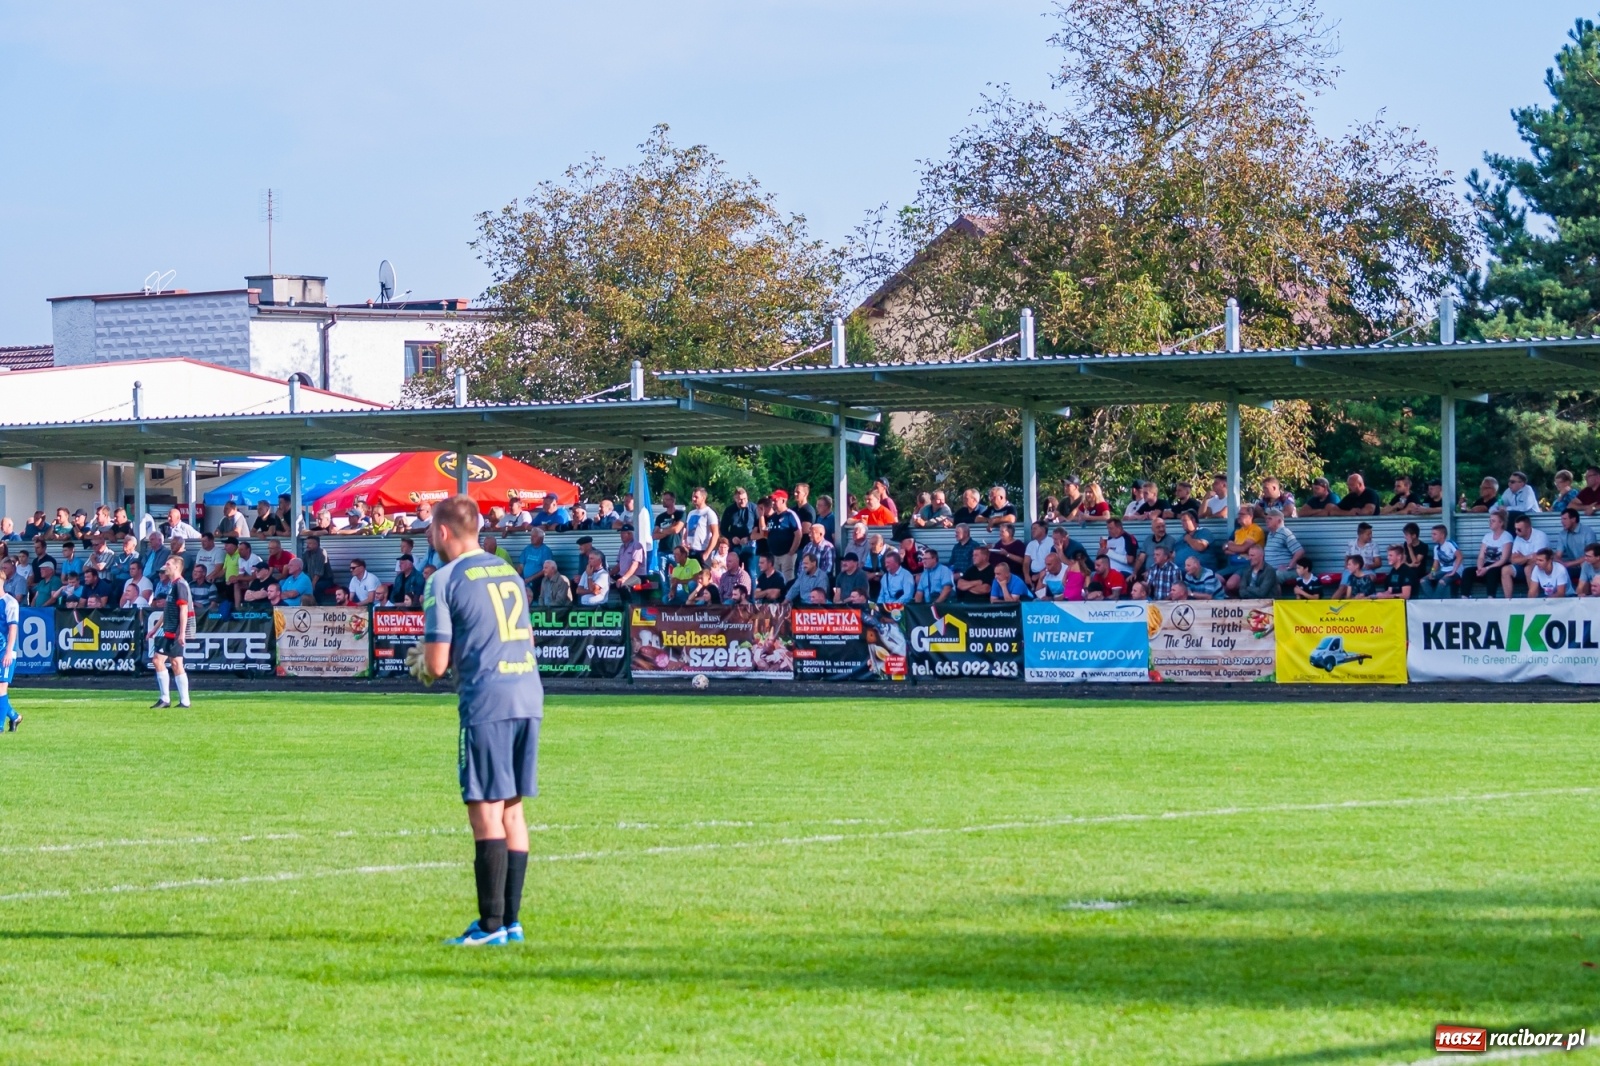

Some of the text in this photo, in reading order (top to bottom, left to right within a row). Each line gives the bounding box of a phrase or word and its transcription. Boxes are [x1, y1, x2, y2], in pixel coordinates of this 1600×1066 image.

[323, 612, 346, 622] Kebab
[487, 581, 530, 642] 12
[662, 612, 694, 622] Producent
[1211, 607, 1243, 618] Kebab
[377, 614, 424, 626] KREWETK
[530, 612, 563, 627] ALL
[795, 612, 858, 625] KREWETKA
[1027, 614, 1060, 624] SZYBKI
[323, 624, 346, 637] Frytki
[969, 628, 1017, 638] BUDUJEMY
[1211, 621, 1242, 634] Frytki
[1294, 626, 1384, 634] POMOC DROGOWA 24h
[1422, 614, 1599, 652] KERAKOLL
[101, 630, 134, 638] BUDUJEMY
[662, 631, 727, 646] kiełbasa
[1032, 632, 1094, 642] INTERNET
[101, 643, 111, 651] OD
[112, 643, 117, 651] A
[131, 643, 135, 651] Z
[323, 638, 342, 649] Lody
[970, 643, 1018, 652] OD A DO Z
[1211, 637, 1236, 650] Lody
[689, 640, 752, 667] szefa
[1040, 648, 1144, 660] ŚWIATŁOWODOWY
[59, 658, 136, 671] tel. 665 092 363
[1221, 657, 1232, 665] tel.
[1233, 657, 1241, 665] 32
[1242, 657, 1253, 665] 729
[1254, 657, 1263, 665] 69
[1264, 657, 1272, 665] 69
[1462, 655, 1598, 666] The GreenBuilding Company
[912, 660, 1018, 676] tel. 665 092 363
[1185, 670, 1212, 678] Tworków,
[1223, 670, 1256, 678] Ogrodowa
